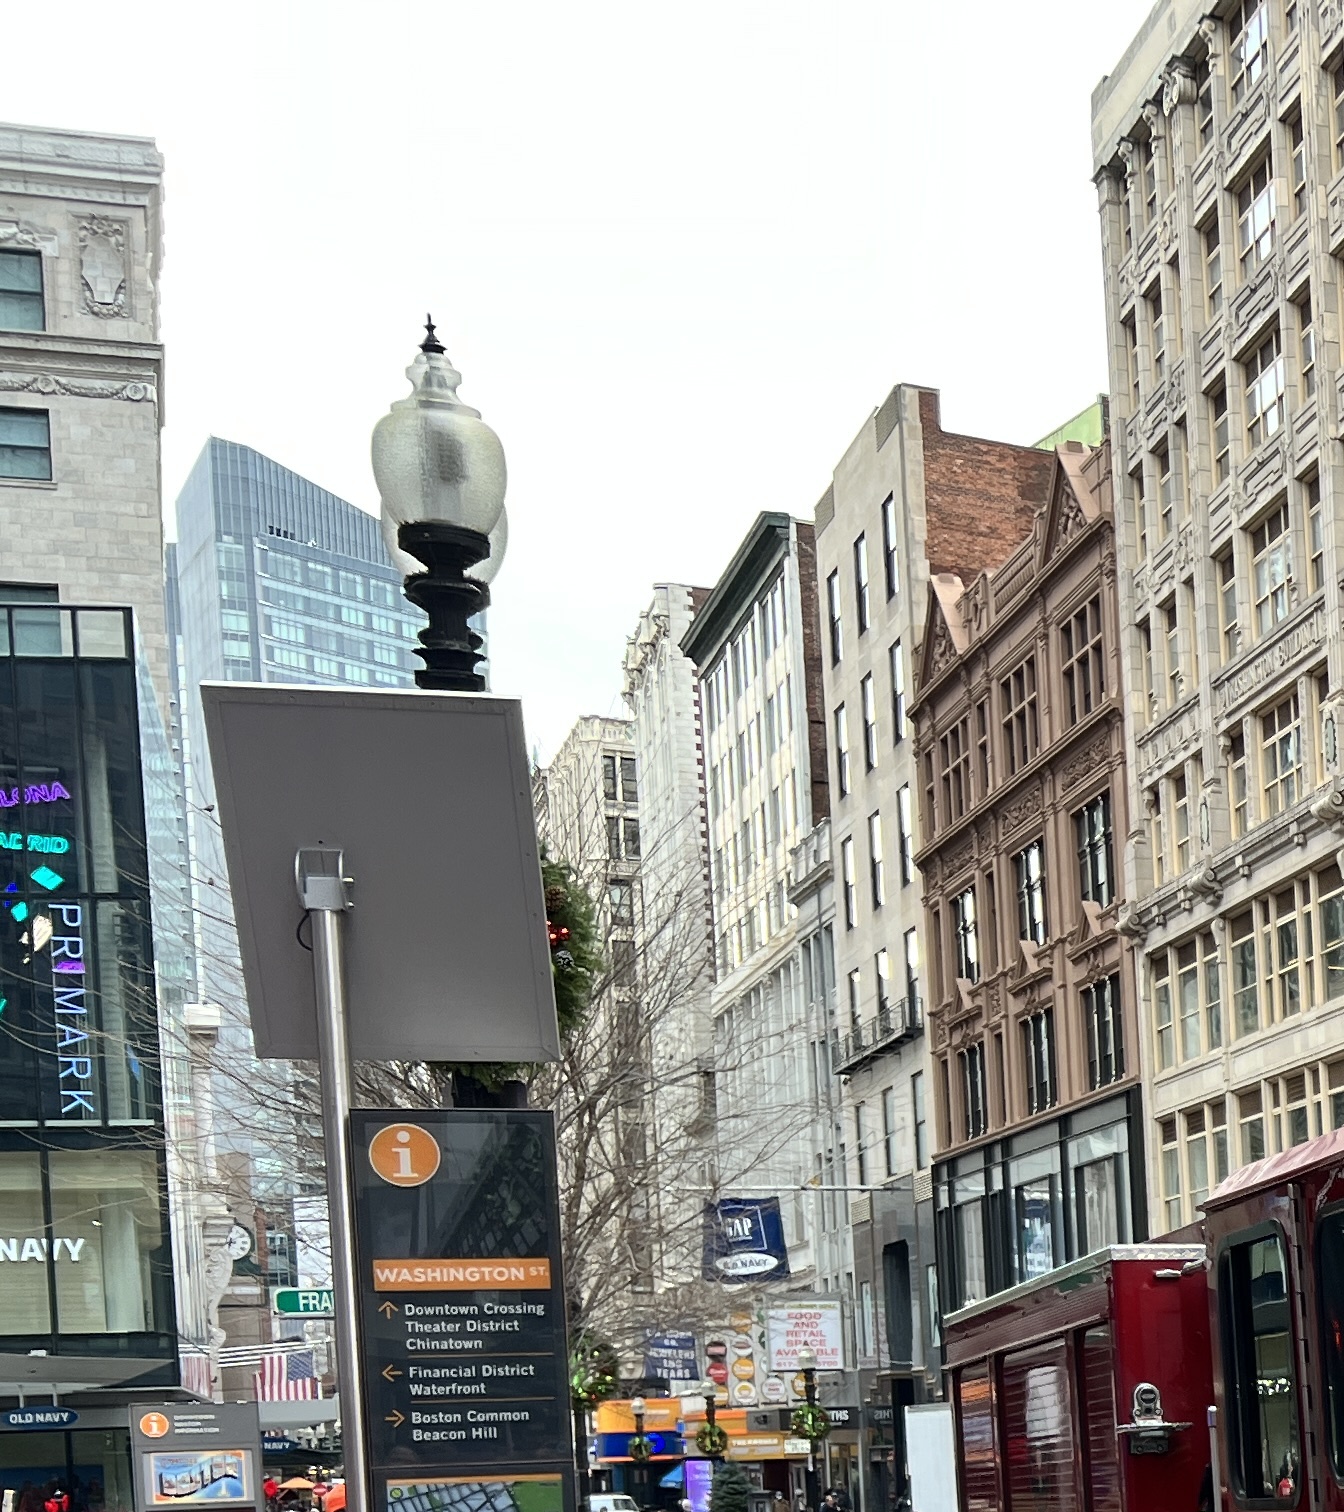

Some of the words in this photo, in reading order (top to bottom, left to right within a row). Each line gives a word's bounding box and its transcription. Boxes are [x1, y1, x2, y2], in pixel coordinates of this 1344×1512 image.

[48, 903, 95, 1113] PRIMARK
[0, 1237, 85, 1262] NAVY
[376, 1266, 525, 1283] WASHINGTON
[298, 1291, 334, 1311] FRA
[404, 1302, 479, 1316] Downtown
[483, 1302, 545, 1316] Crossing
[787, 1312, 822, 1320] FOOD
[405, 1320, 461, 1333] Theater
[466, 1319, 520, 1332] District
[793, 1321, 819, 1329] AND
[406, 1337, 483, 1350] Chinatown
[775, 1348, 839, 1357] AVABLE
[408, 1365, 477, 1379] Financial
[481, 1364, 535, 1377] District
[656, 1367, 691, 1379] YEARS
[409, 1382, 487, 1396] Waterfront
[9, 1412, 34, 1425] OLD
[35, 1412, 69, 1424] NAVY
[411, 1411, 462, 1424] Boston
[467, 1410, 530, 1423] Common
[412, 1428, 466, 1442] Beacon
[471, 1427, 498, 1439] Hill
